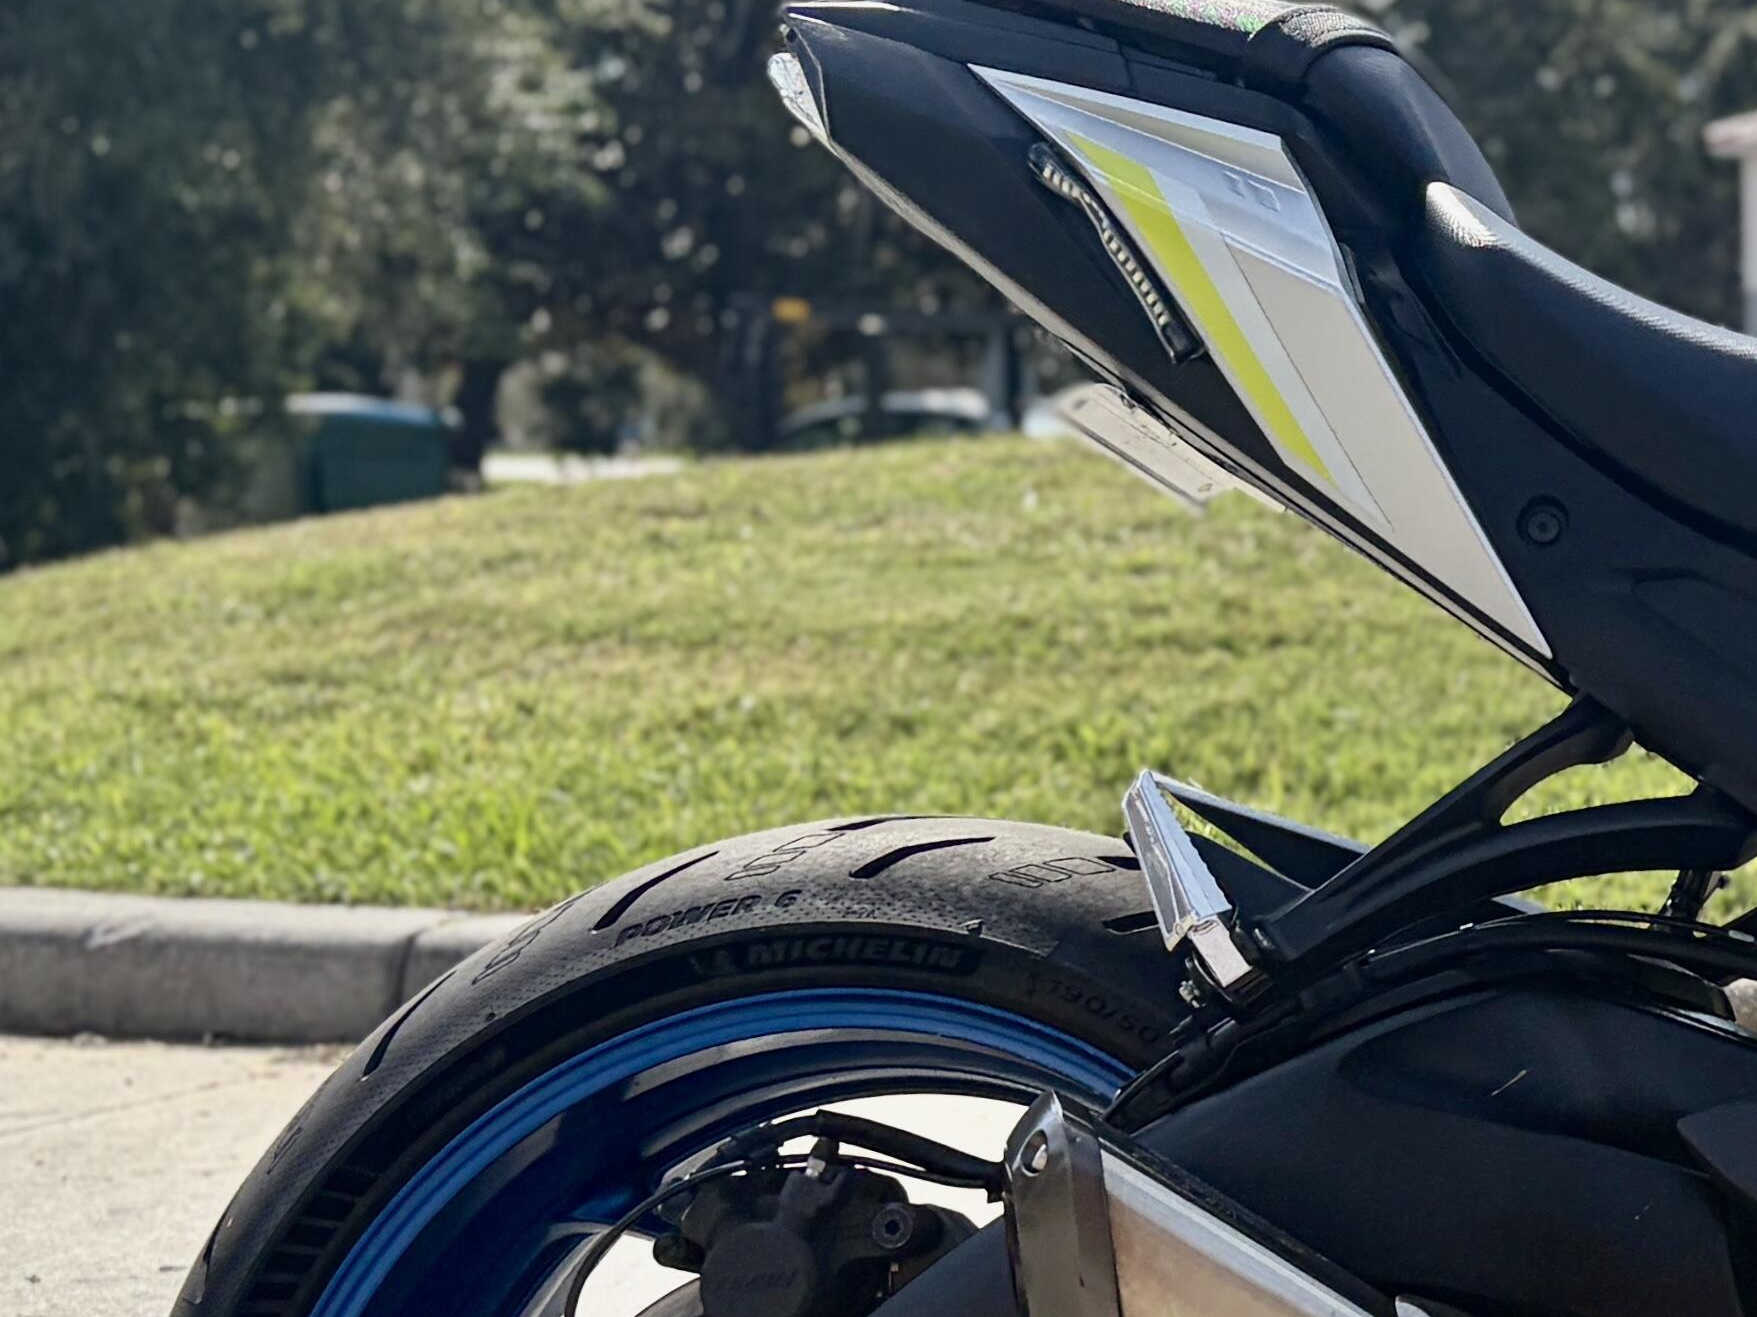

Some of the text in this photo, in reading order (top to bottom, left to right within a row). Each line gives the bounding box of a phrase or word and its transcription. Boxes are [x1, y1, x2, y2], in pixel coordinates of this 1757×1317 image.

[614, 889, 802, 949] POWER 6
[750, 936, 963, 968] MICHELIN
